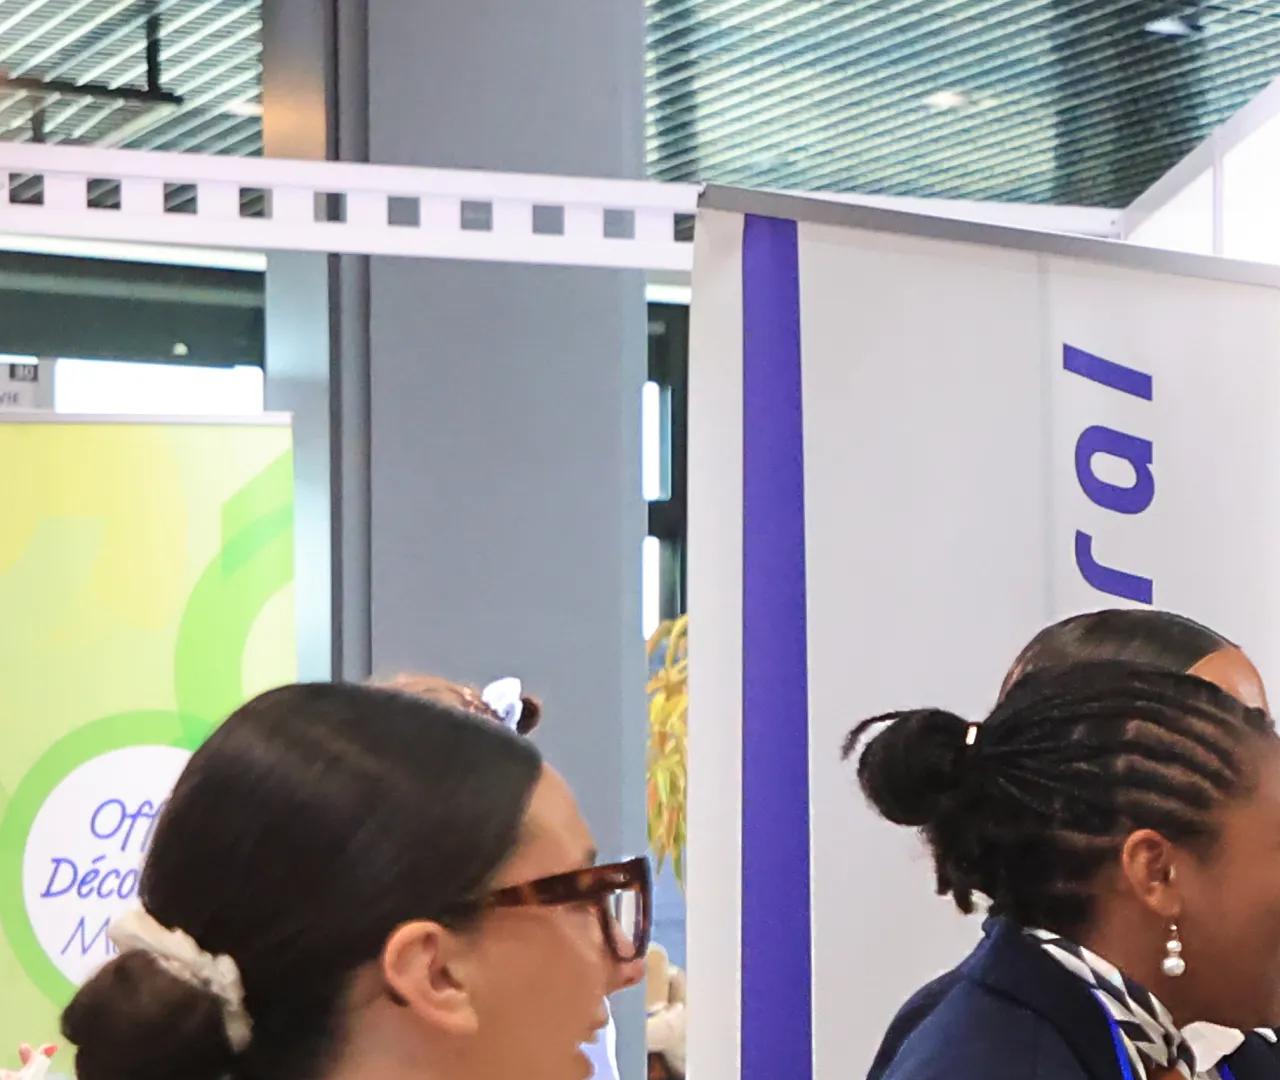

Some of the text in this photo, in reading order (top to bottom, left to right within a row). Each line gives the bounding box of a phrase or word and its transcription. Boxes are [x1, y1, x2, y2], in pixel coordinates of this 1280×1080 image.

[1062, 341, 1156, 606] ral
[40, 853, 140, 899] Déco
[60, 915, 119, 957] M
